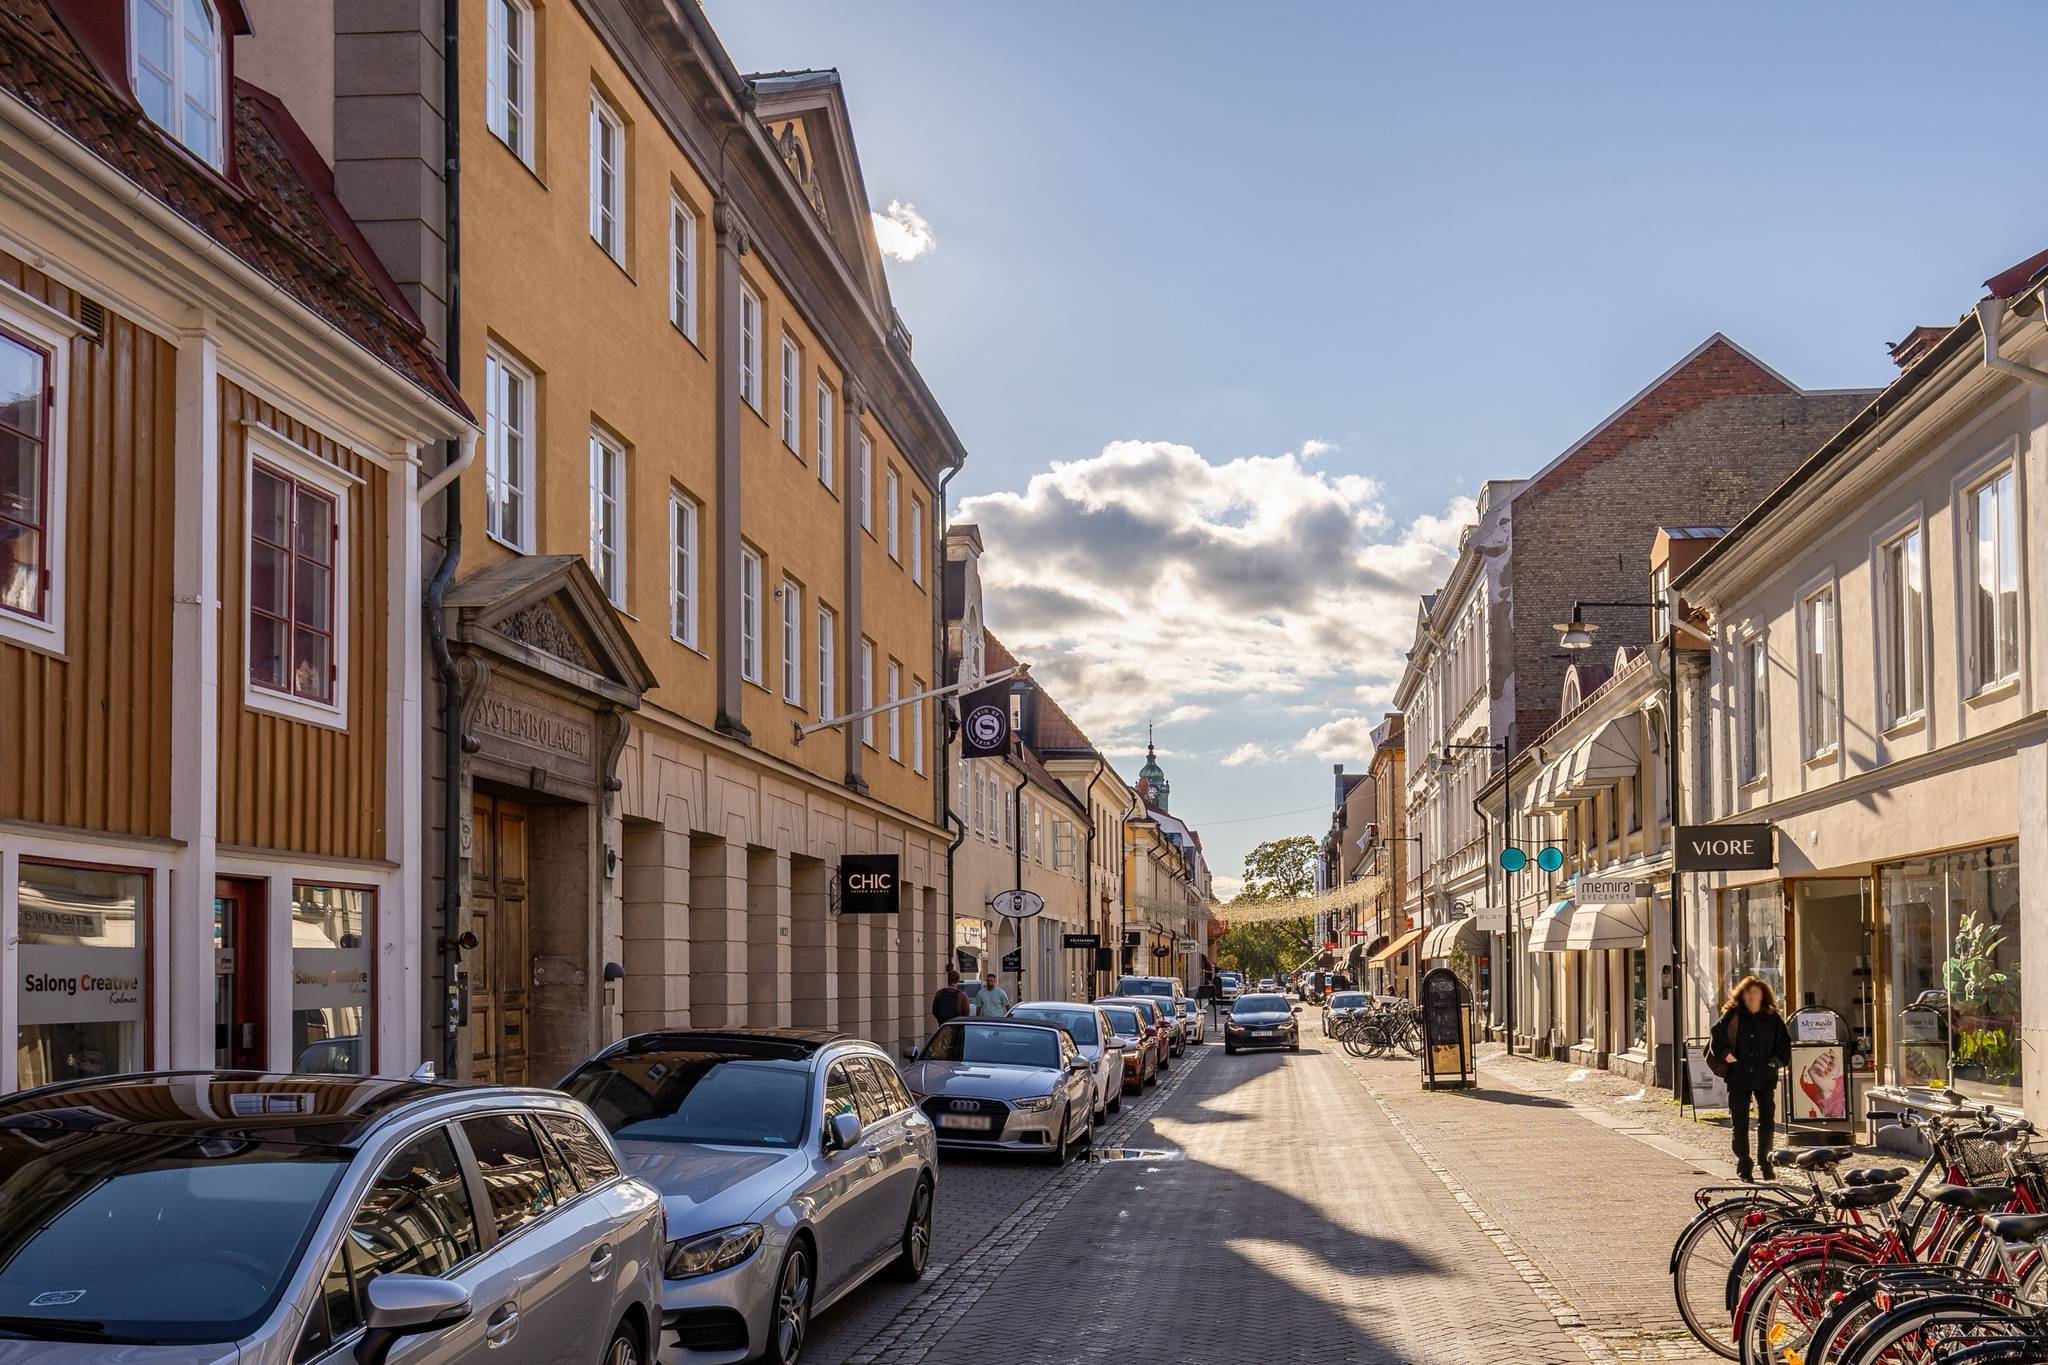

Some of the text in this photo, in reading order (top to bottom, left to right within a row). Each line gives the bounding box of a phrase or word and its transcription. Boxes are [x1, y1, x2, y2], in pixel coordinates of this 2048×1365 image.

[475, 696, 587, 756] SYSTEMBOLAGET
[1692, 840, 1754, 856] VIORE
[849, 873, 892, 889] CHIC
[1582, 882, 1630, 893] memira
[25, 974, 138, 996] Salong Creative
[109, 991, 137, 1004] Kalmar
